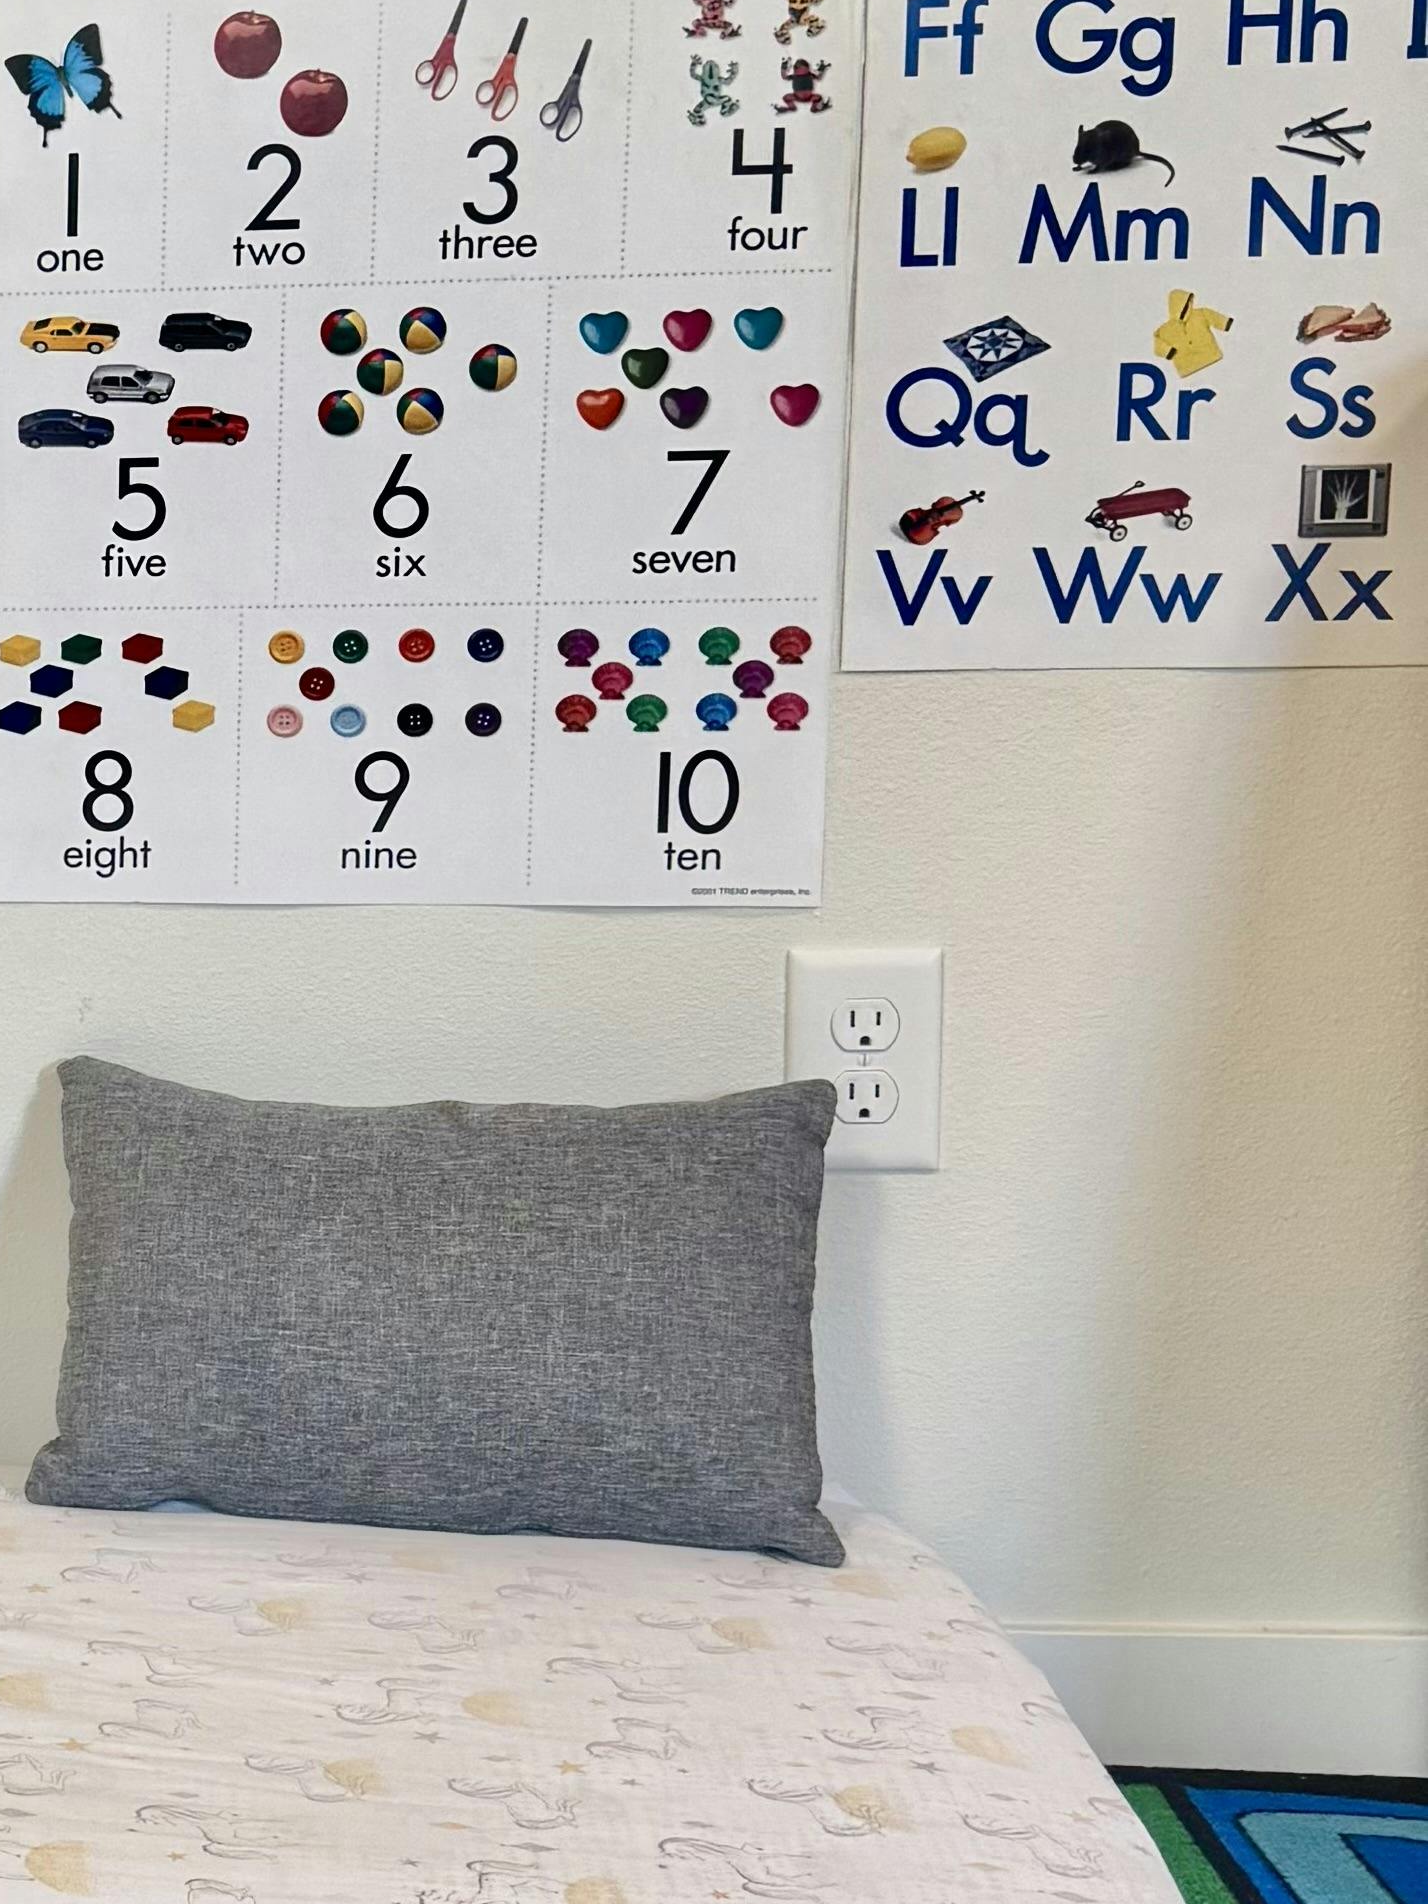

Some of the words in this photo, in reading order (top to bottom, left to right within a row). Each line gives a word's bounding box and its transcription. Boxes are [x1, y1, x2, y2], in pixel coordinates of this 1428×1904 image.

[67, 153, 80, 238] 1
[244, 143, 303, 232] 2
[462, 135, 520, 224] 3
[732, 127, 794, 215] 4
[36, 244, 104, 274] one
[233, 236, 306, 267] two
[438, 224, 538, 260] three
[726, 221, 808, 253] four
[899, 186, 960, 267] Ll
[1018, 181, 1190, 264] Mm
[1248, 175, 1381, 257] Nn
[886, 366, 1051, 467] Qq
[1116, 361, 1218, 442] Rr
[1286, 357, 1377, 440] Ss
[111, 457, 167, 541] 5
[373, 454, 430, 539] 6
[665, 449, 730, 536] 7
[100, 547, 168, 578] five
[376, 547, 427, 577] six
[632, 546, 738, 575] seven
[875, 548, 994, 626] Vv
[1032, 545, 1224, 624] Ww
[1265, 542, 1394, 622] Xx
[82, 750, 134, 832] 8
[354, 750, 411, 834] 9
[656, 749, 741, 835] 10
[62, 840, 152, 878] eight
[340, 841, 418, 871] nine
[664, 843, 723, 872] ten
